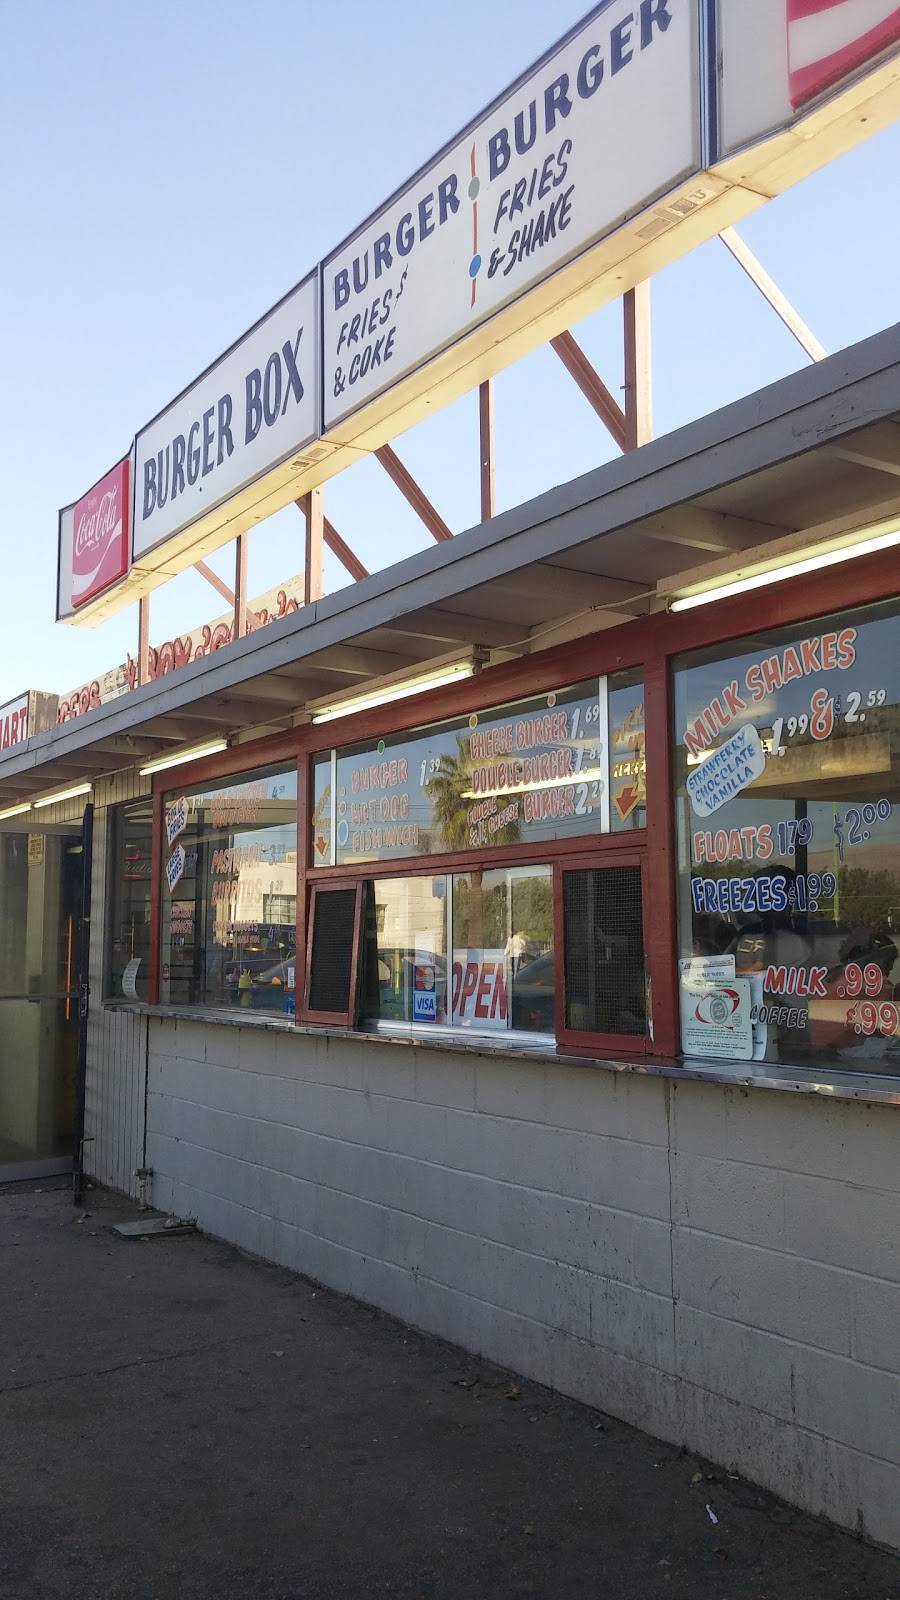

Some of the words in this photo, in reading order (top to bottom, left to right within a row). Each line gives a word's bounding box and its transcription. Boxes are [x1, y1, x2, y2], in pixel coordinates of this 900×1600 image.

[488, 0, 673, 182] BURGER
[493, 139, 572, 234] FRIES
[334, 173, 461, 311] BURGER
[487, 247, 503, 280] &
[503, 184, 575, 276] SHAKE
[333, 365, 347, 398] &
[348, 326, 397, 386] COKE
[142, 393, 235, 521] BURGER
[244, 326, 304, 446] BOX
[684, 680, 747, 759] MILK
[745, 628, 857, 702] SHAKES
[469, 726, 513, 760] CHEESE
[515, 711, 569, 752] BURGER
[419, 758, 441, 787] 1.39
[472, 763, 522, 796] DOUBLE
[522, 747, 573, 788] BURGER
[694, 744, 756, 802] CHOCOLATE
[705, 766, 755, 811] VANILLA
[168, 810, 186, 841] FRIES
[522, 785, 575, 824] BURGER
[693, 824, 773, 864] FLOATS
[776, 818, 813, 857] 1.79
[169, 856, 182, 884] FRIES
[691, 875, 788, 914] FREEZES
[416, 999, 434, 1010] VISA
[443, 962, 509, 1020] OPEN
[763, 965, 828, 997] MILK
[836, 962, 884, 998] .99
[750, 1006, 809, 1029] COFFEE
